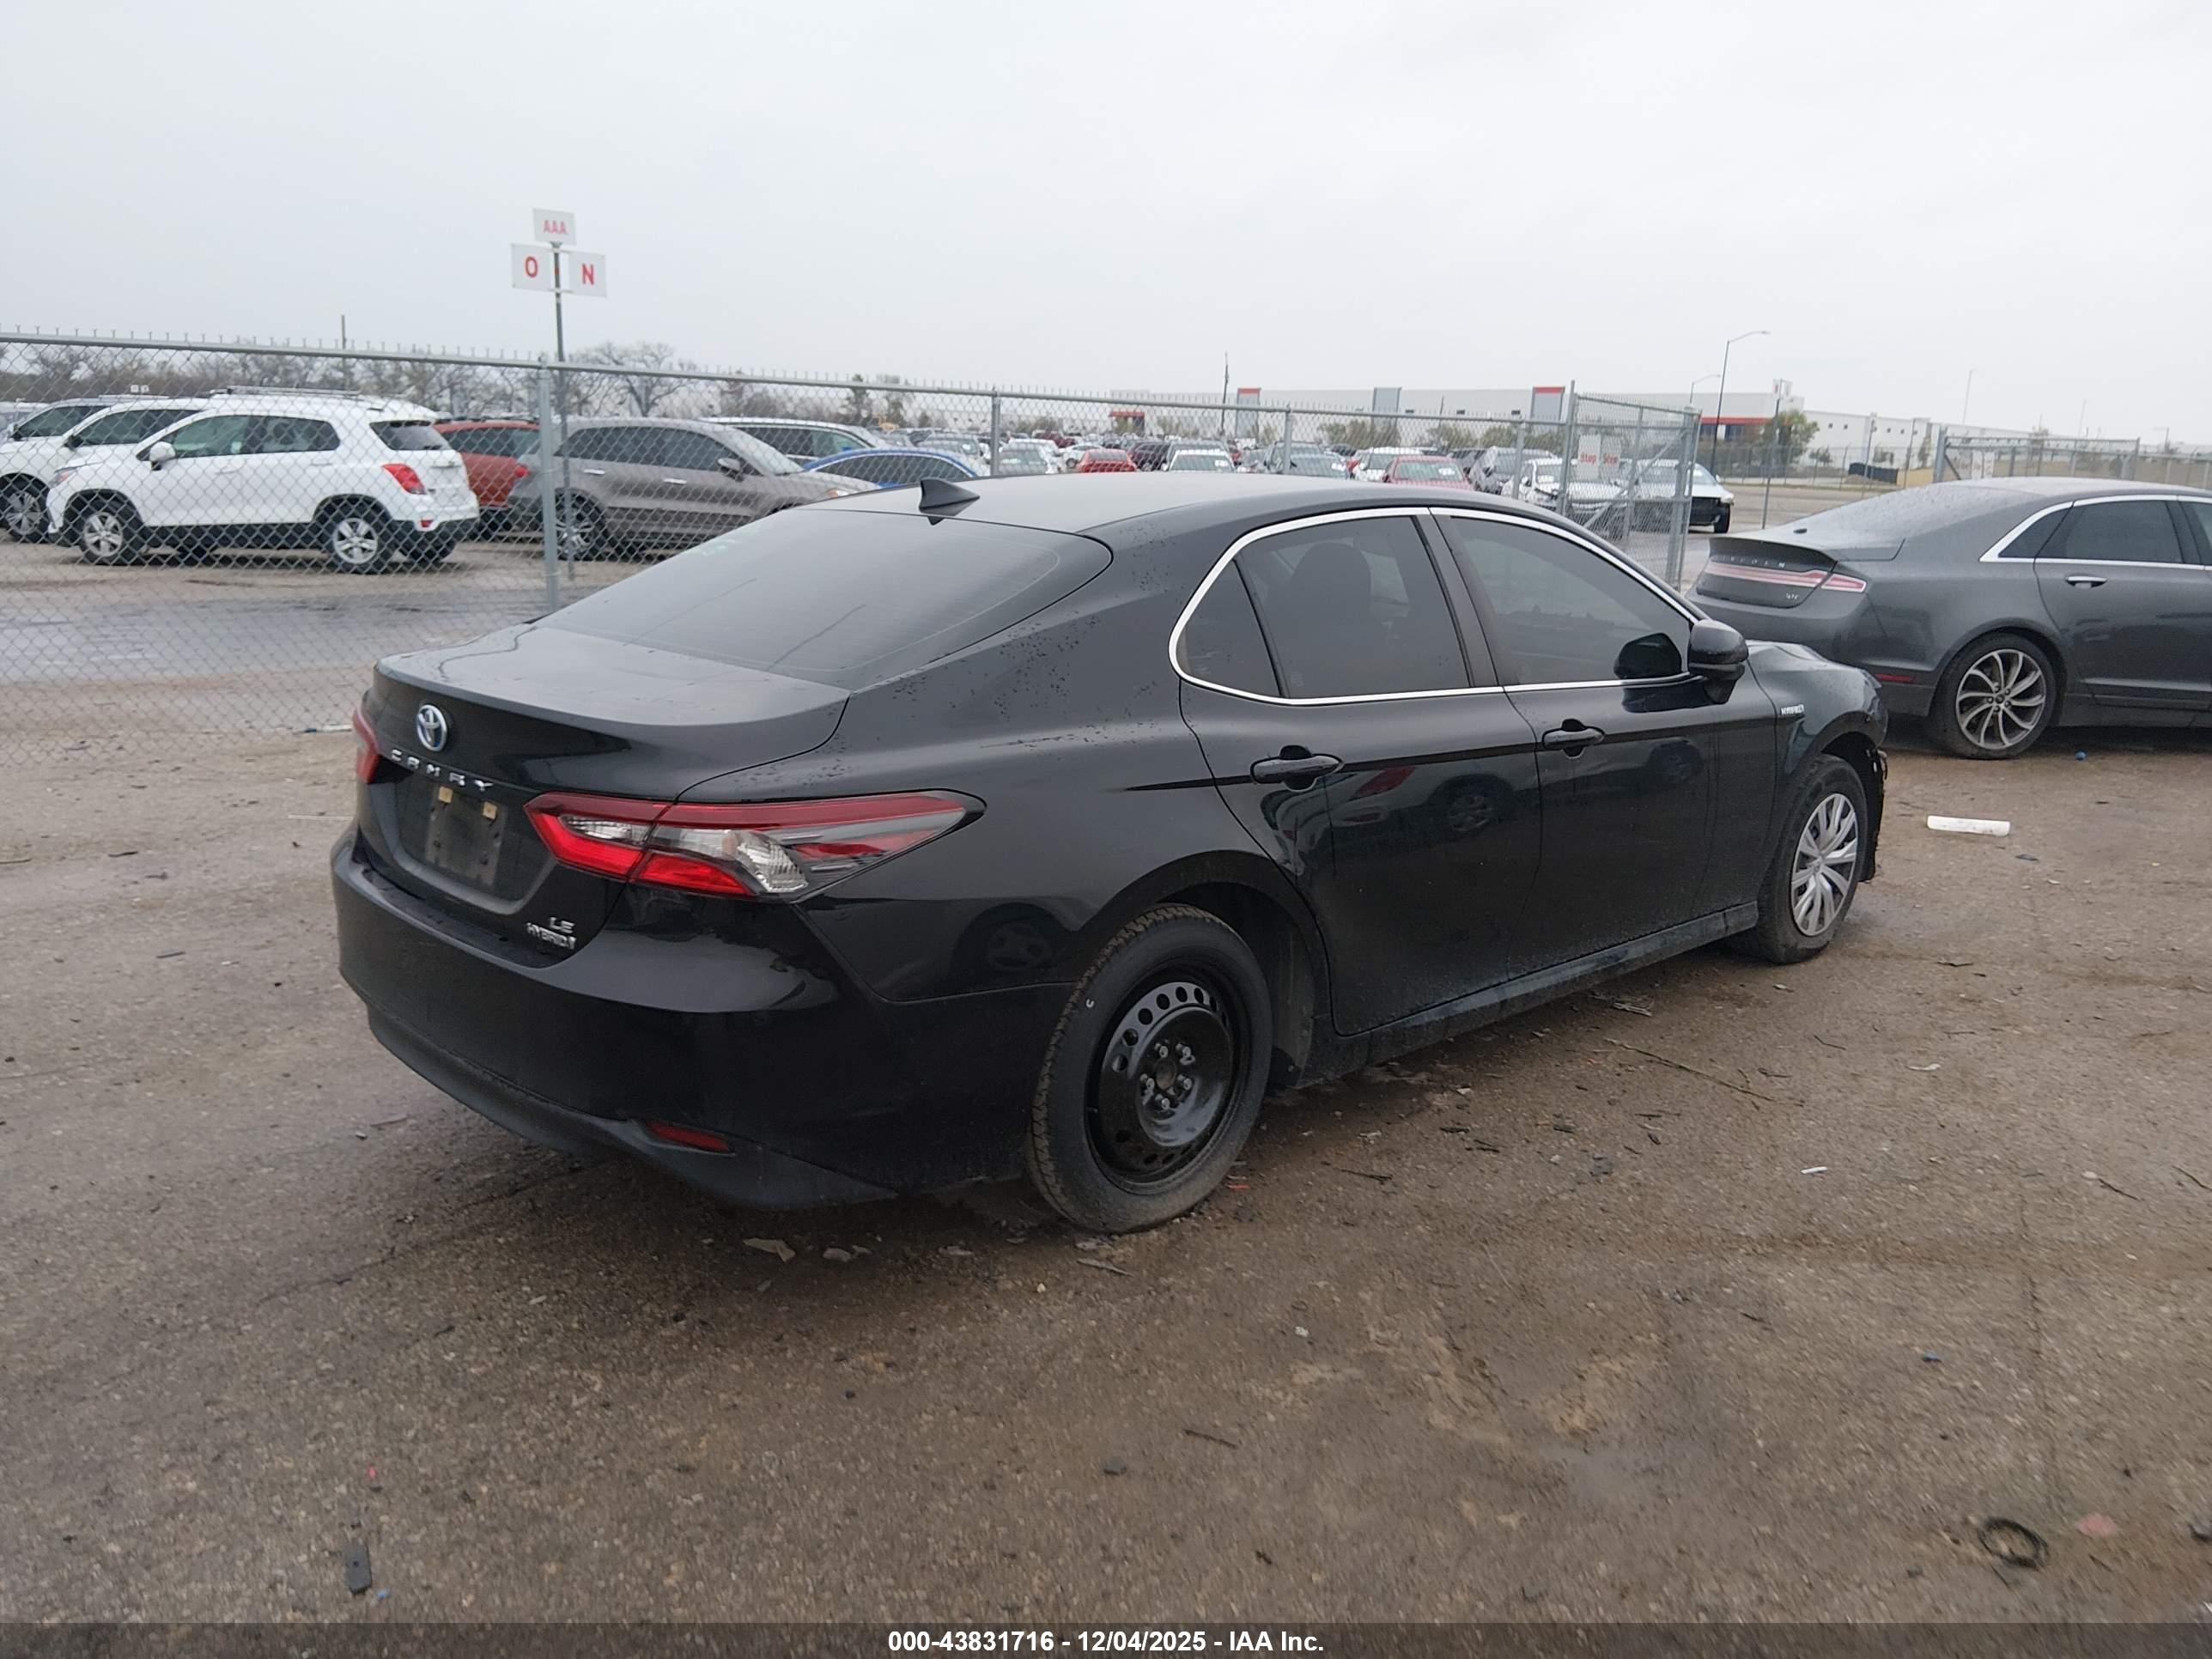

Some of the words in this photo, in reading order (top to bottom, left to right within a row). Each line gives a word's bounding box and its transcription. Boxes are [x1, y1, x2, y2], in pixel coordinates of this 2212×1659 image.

[543, 219, 568, 234] AAA
[581, 263, 595, 285] N
[392, 749, 493, 792] CAMRY
[550, 916, 575, 933] LE
